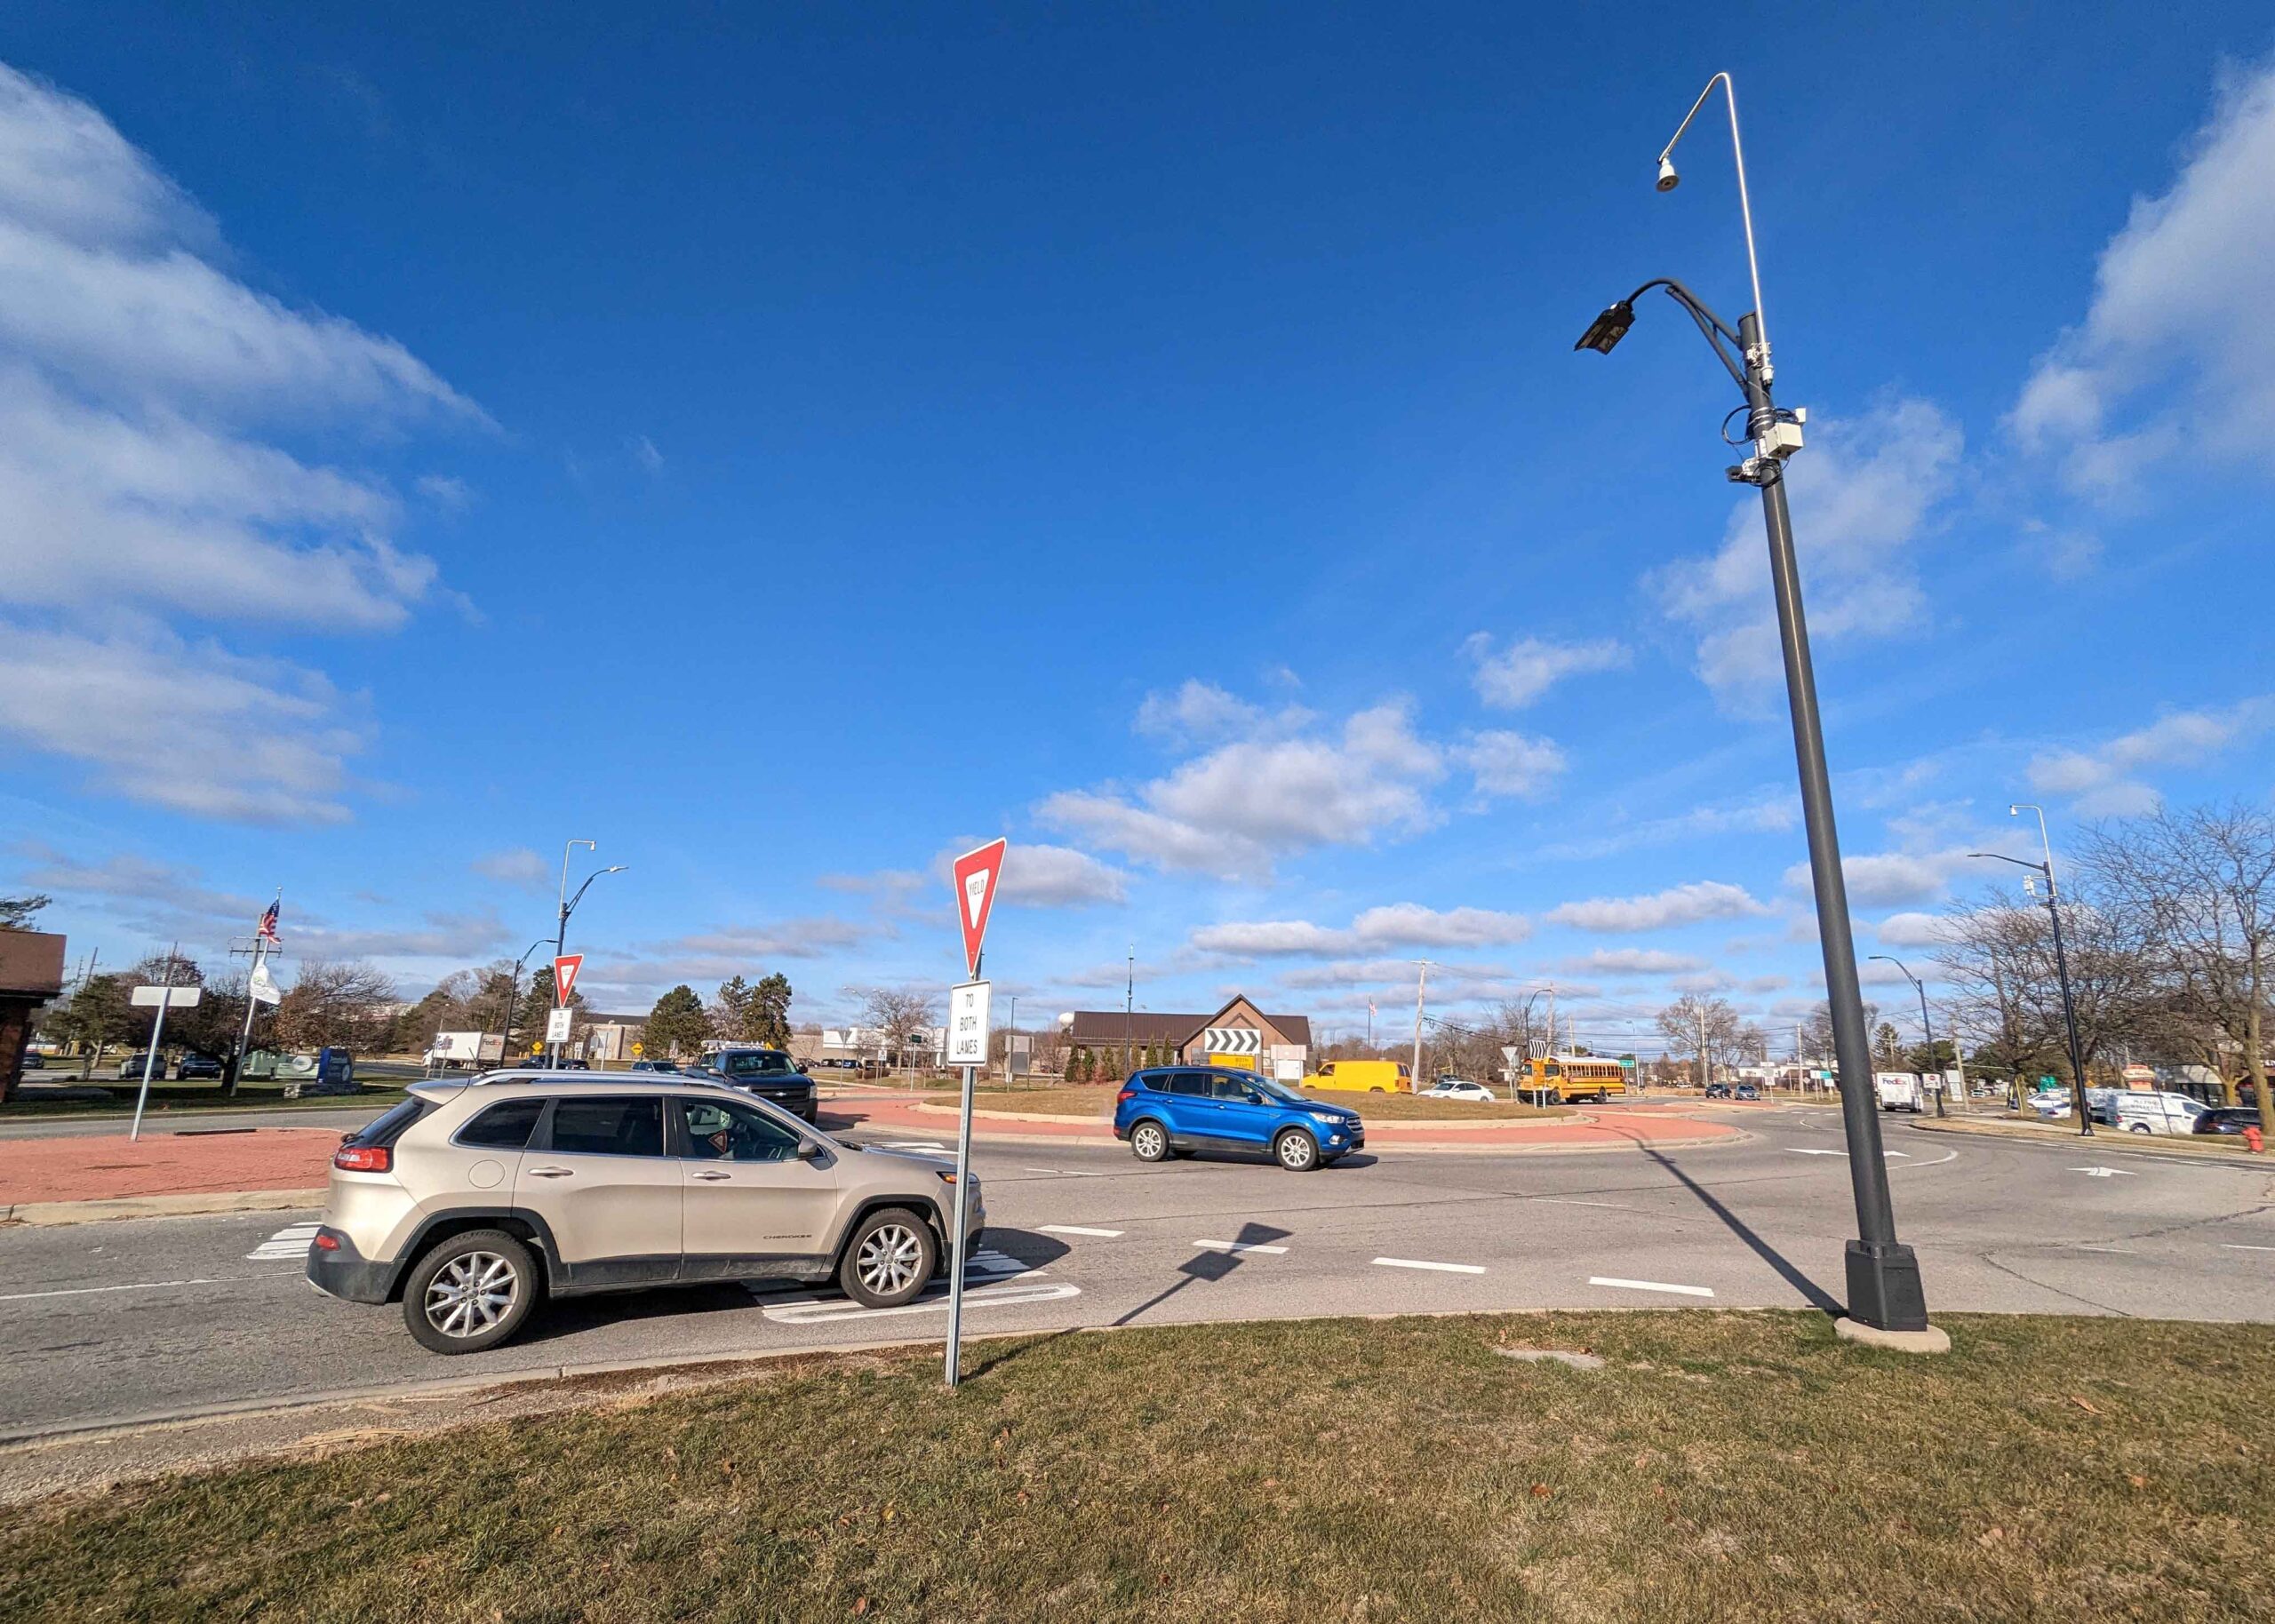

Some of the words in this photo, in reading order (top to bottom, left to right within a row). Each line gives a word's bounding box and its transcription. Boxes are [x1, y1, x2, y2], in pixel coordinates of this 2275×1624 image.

[969, 879, 985, 896] YIELD
[965, 993, 974, 1008] TO
[960, 1016, 978, 1031] BOTH
[956, 1039, 978, 1055] LANES
[1882, 1077, 1908, 1086] FedEx
